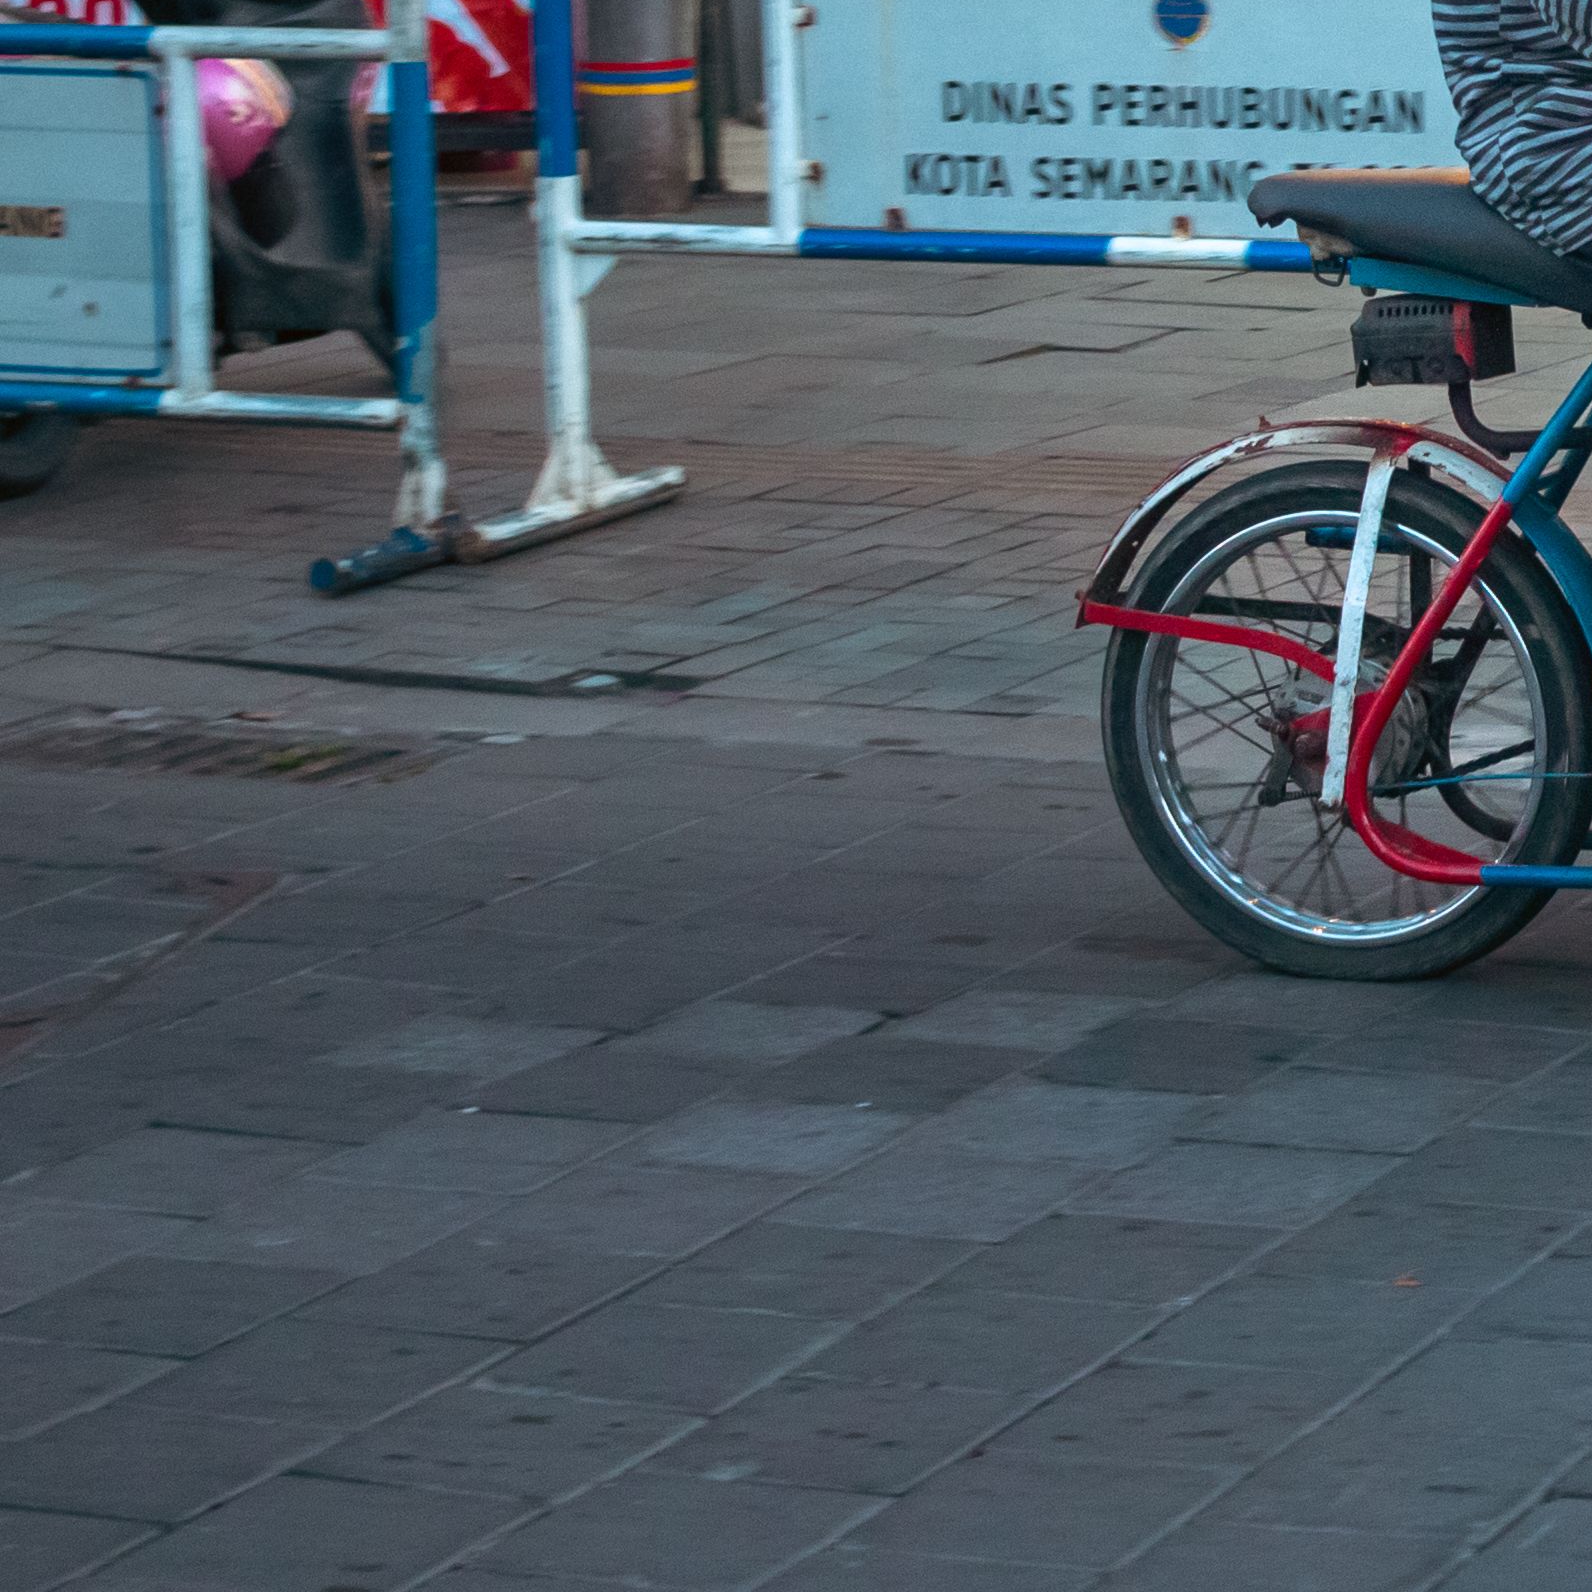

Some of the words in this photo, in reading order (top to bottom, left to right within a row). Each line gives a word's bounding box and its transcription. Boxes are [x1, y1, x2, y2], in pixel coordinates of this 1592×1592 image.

[941, 79, 1073, 126] DINAS
[1091, 82, 1426, 133] PERHUBUNGAN
[903, 151, 1012, 197] KOTA
